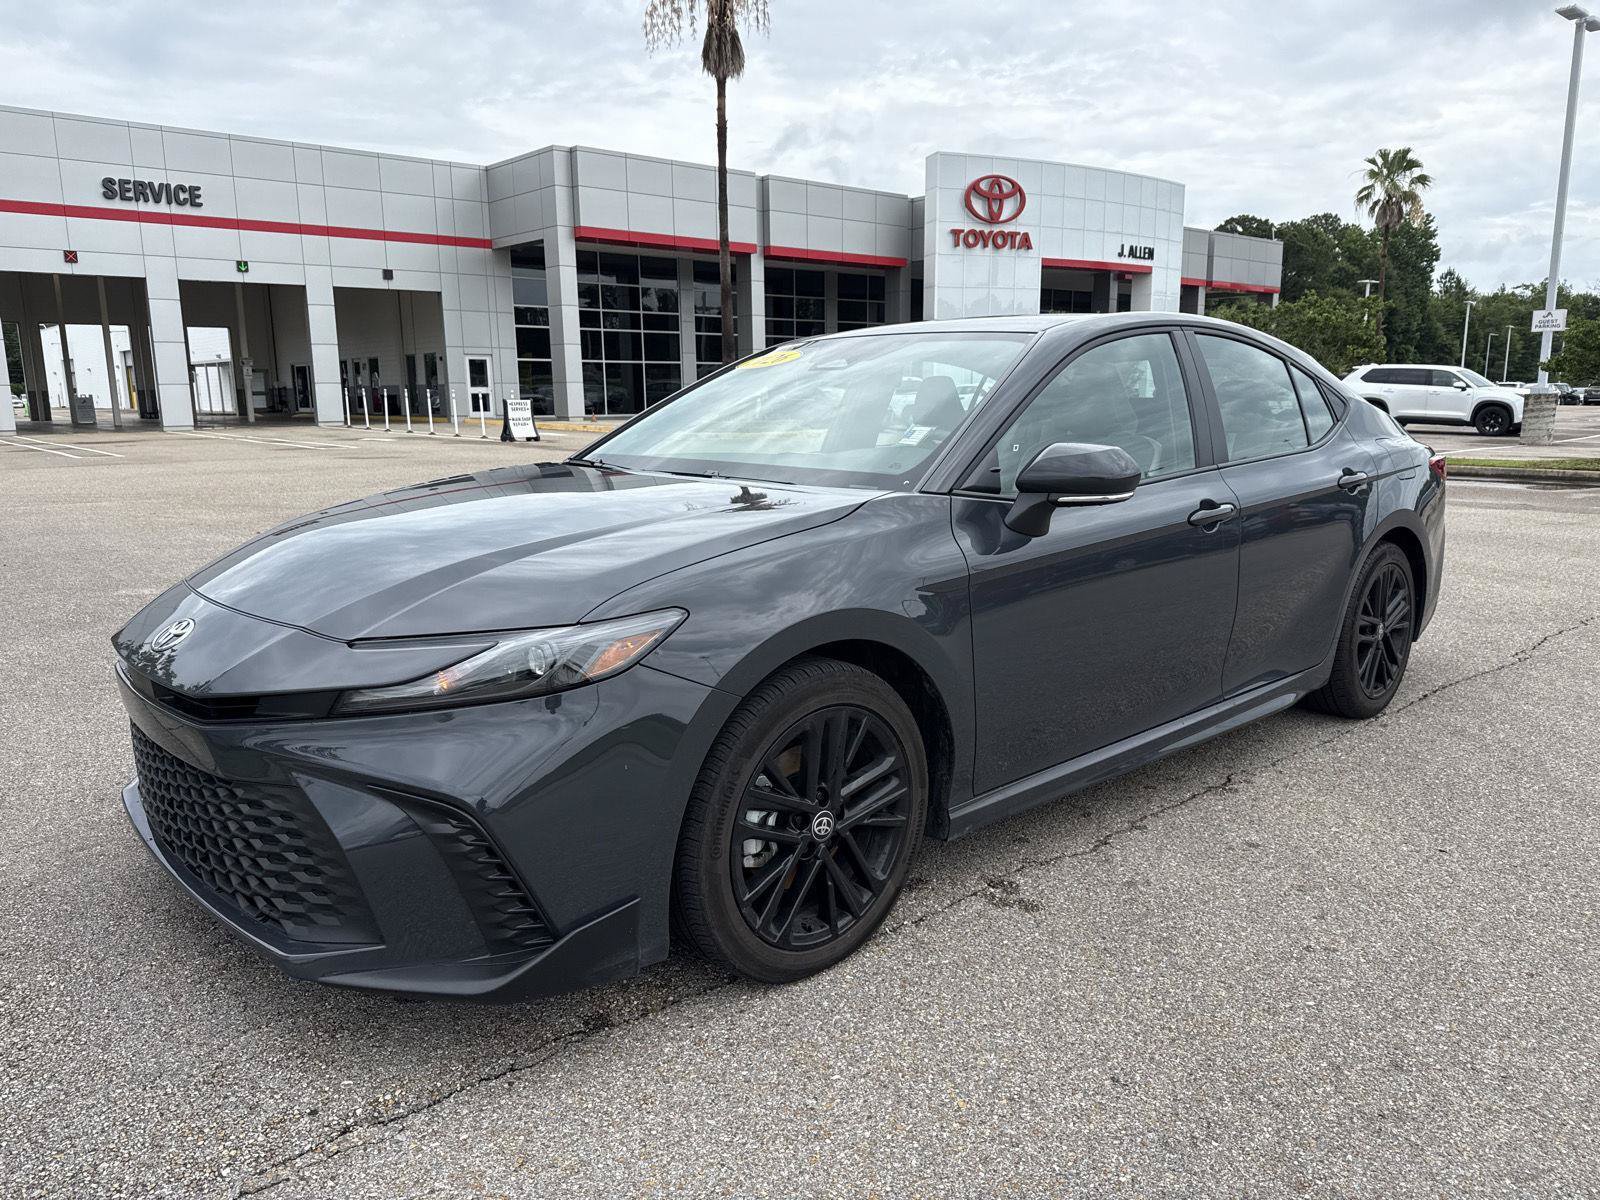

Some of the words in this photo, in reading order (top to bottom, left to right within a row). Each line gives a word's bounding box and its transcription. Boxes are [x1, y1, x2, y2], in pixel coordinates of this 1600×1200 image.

[101, 177, 203, 207] SERVICE
[951, 229, 1033, 250] TOYOTA
[1117, 243, 1126, 258] J.
[1128, 245, 1154, 261] ALLEN
